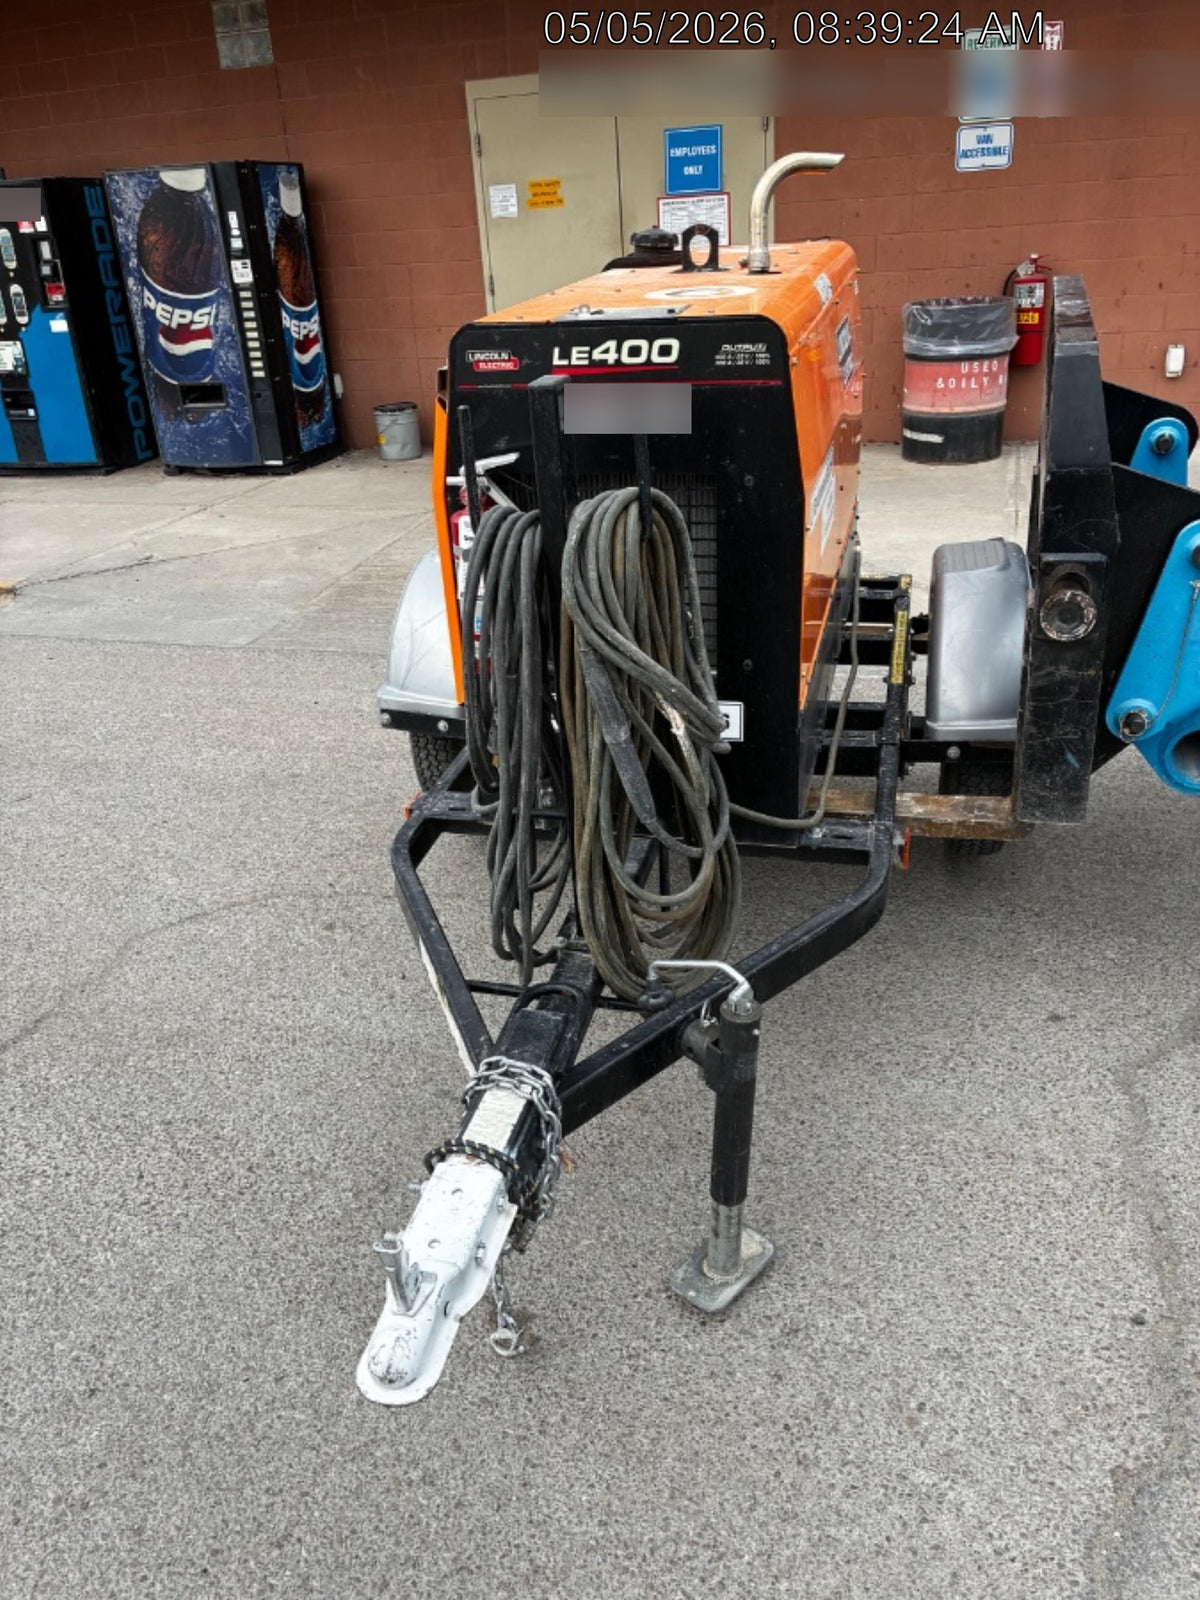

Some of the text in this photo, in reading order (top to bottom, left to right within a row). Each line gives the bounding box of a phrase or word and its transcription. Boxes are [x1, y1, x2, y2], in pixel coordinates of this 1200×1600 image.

[670, 144, 717, 157] EMPLOYEES
[960, 146, 1008, 159] ACCESSIBLE
[683, 164, 703, 176] ONLY
[143, 286, 217, 331] PEPSI
[84, 186, 151, 461] POWERADE
[468, 351, 509, 361] LINCOLN
[552, 338, 680, 366] LE400
[479, 361, 514, 370] ELECTRIC
[961, 360, 998, 374] USED
